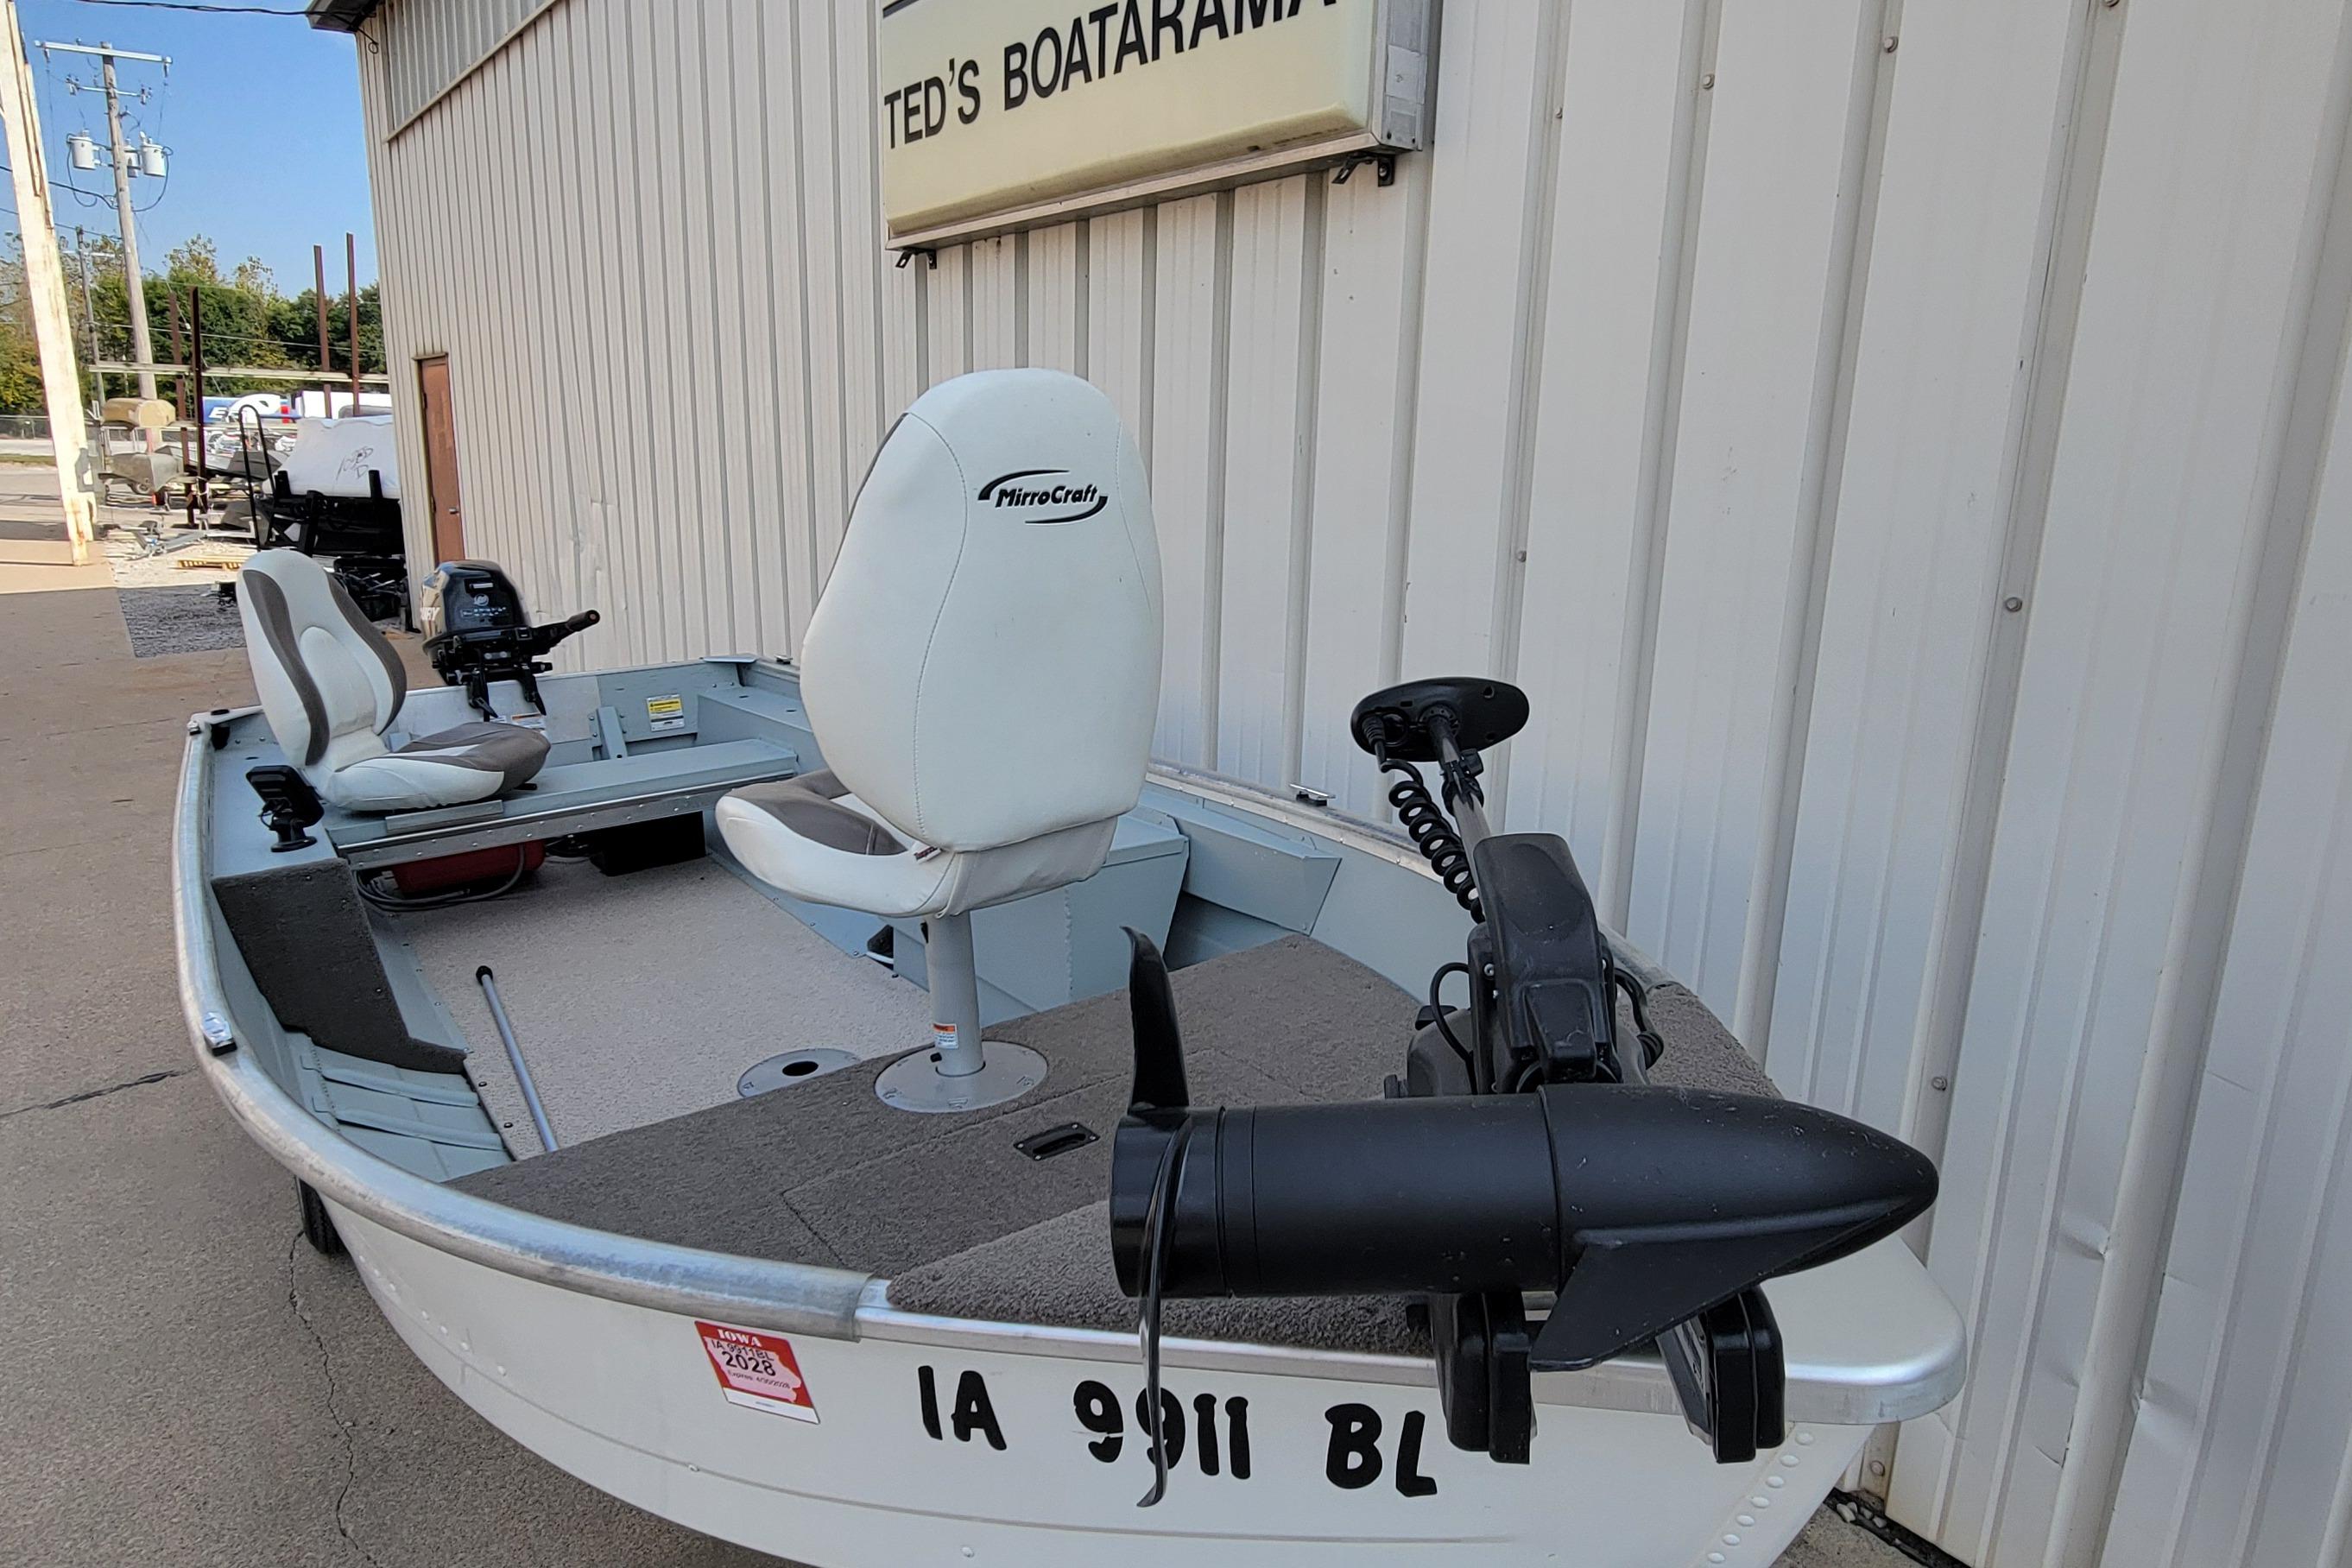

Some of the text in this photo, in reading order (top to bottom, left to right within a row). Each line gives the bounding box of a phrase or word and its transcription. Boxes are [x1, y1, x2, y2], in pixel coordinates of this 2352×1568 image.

[883, 0, 1337, 149] TED'S BOATARA
[996, 484, 1098, 508] MirroCraft
[712, 1341, 724, 1350] IA
[718, 1330, 762, 1347] IOWA
[723, 1351, 775, 1376] 2028
[918, 1365, 1437, 1496] IA 9911 BL
